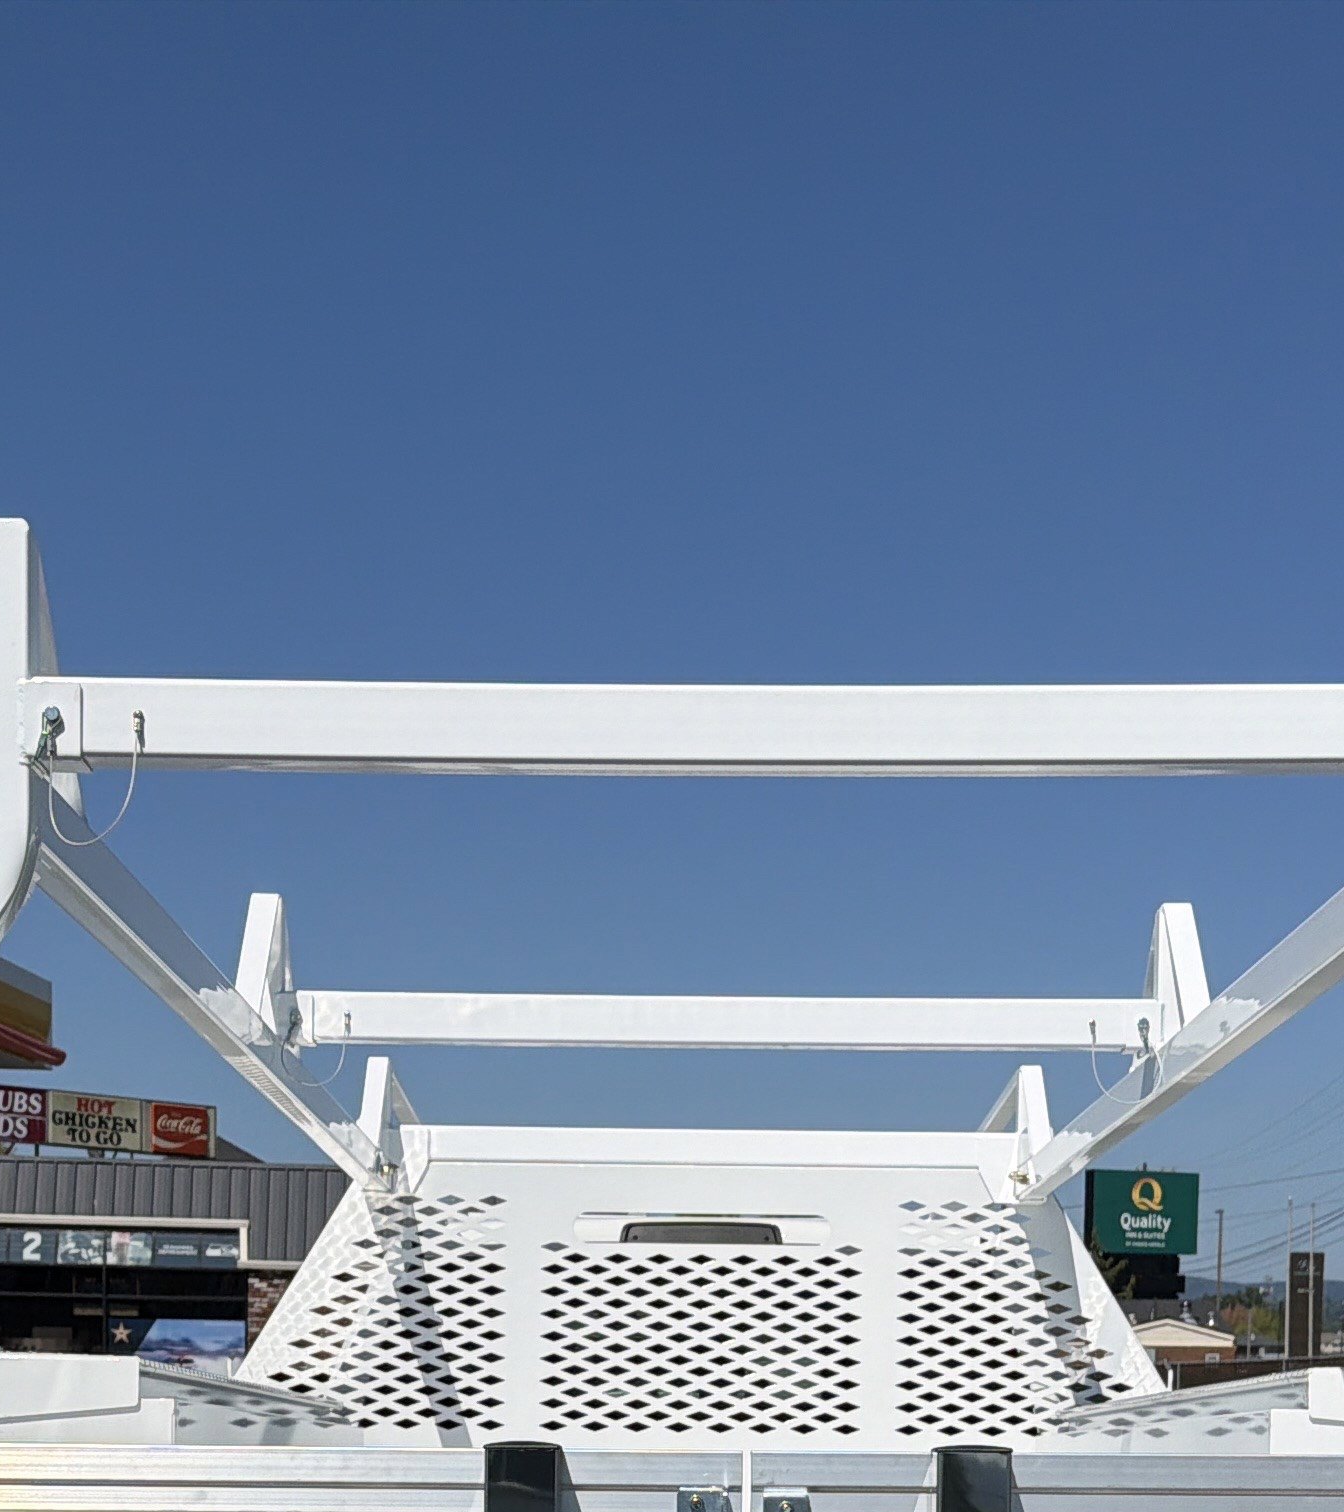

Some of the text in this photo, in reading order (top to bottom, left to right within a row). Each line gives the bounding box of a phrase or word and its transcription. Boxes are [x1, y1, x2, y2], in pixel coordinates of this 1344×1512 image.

[76, 1097, 116, 1114] HOT
[52, 1110, 138, 1134] CHICKEN
[66, 1126, 123, 1147] TO GO
[1119, 1212, 1172, 1234] Quality
